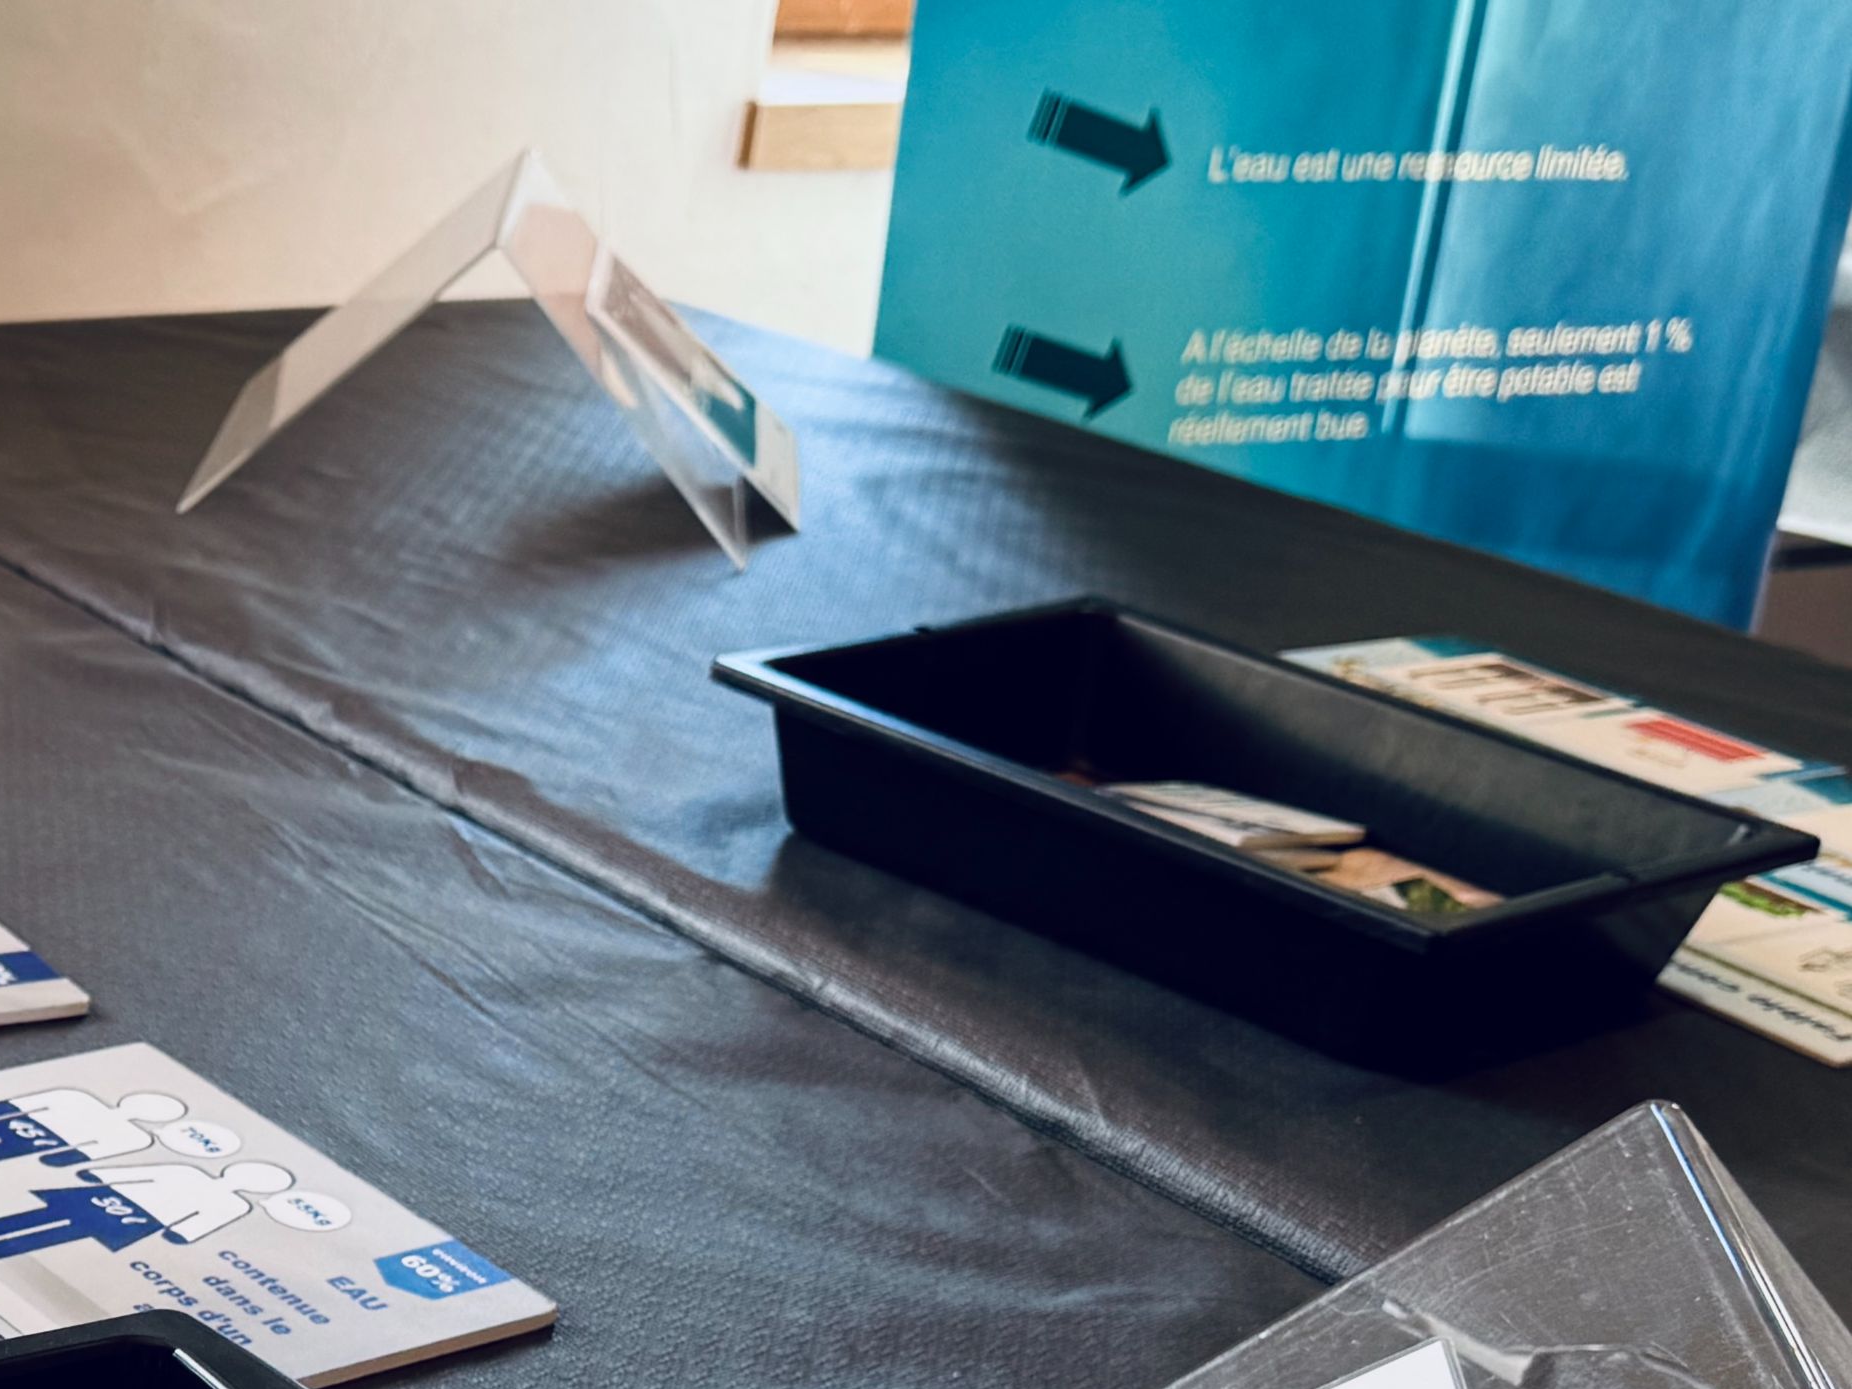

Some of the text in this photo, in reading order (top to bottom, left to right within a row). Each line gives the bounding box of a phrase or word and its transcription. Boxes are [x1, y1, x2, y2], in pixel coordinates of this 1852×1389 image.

[1208, 145, 1290, 183] L'eau
[1292, 147, 1340, 182] est
[1341, 151, 1395, 182] une
[1535, 144, 1629, 182] limitée.
[1325, 327, 1363, 361] de
[1506, 321, 1642, 356] seulement
[1646, 319, 1662, 353] 1
[1175, 373, 1214, 406] de
[1497, 360, 1596, 403] potable
[1598, 359, 1642, 394] est
[218, 1249, 331, 1326] contenue
[326, 1275, 389, 1312] EAU
[401, 1254, 461, 1293] 60%
[129, 1259, 253, 1347] corps d'un
[203, 1274, 292, 1337] dans le
